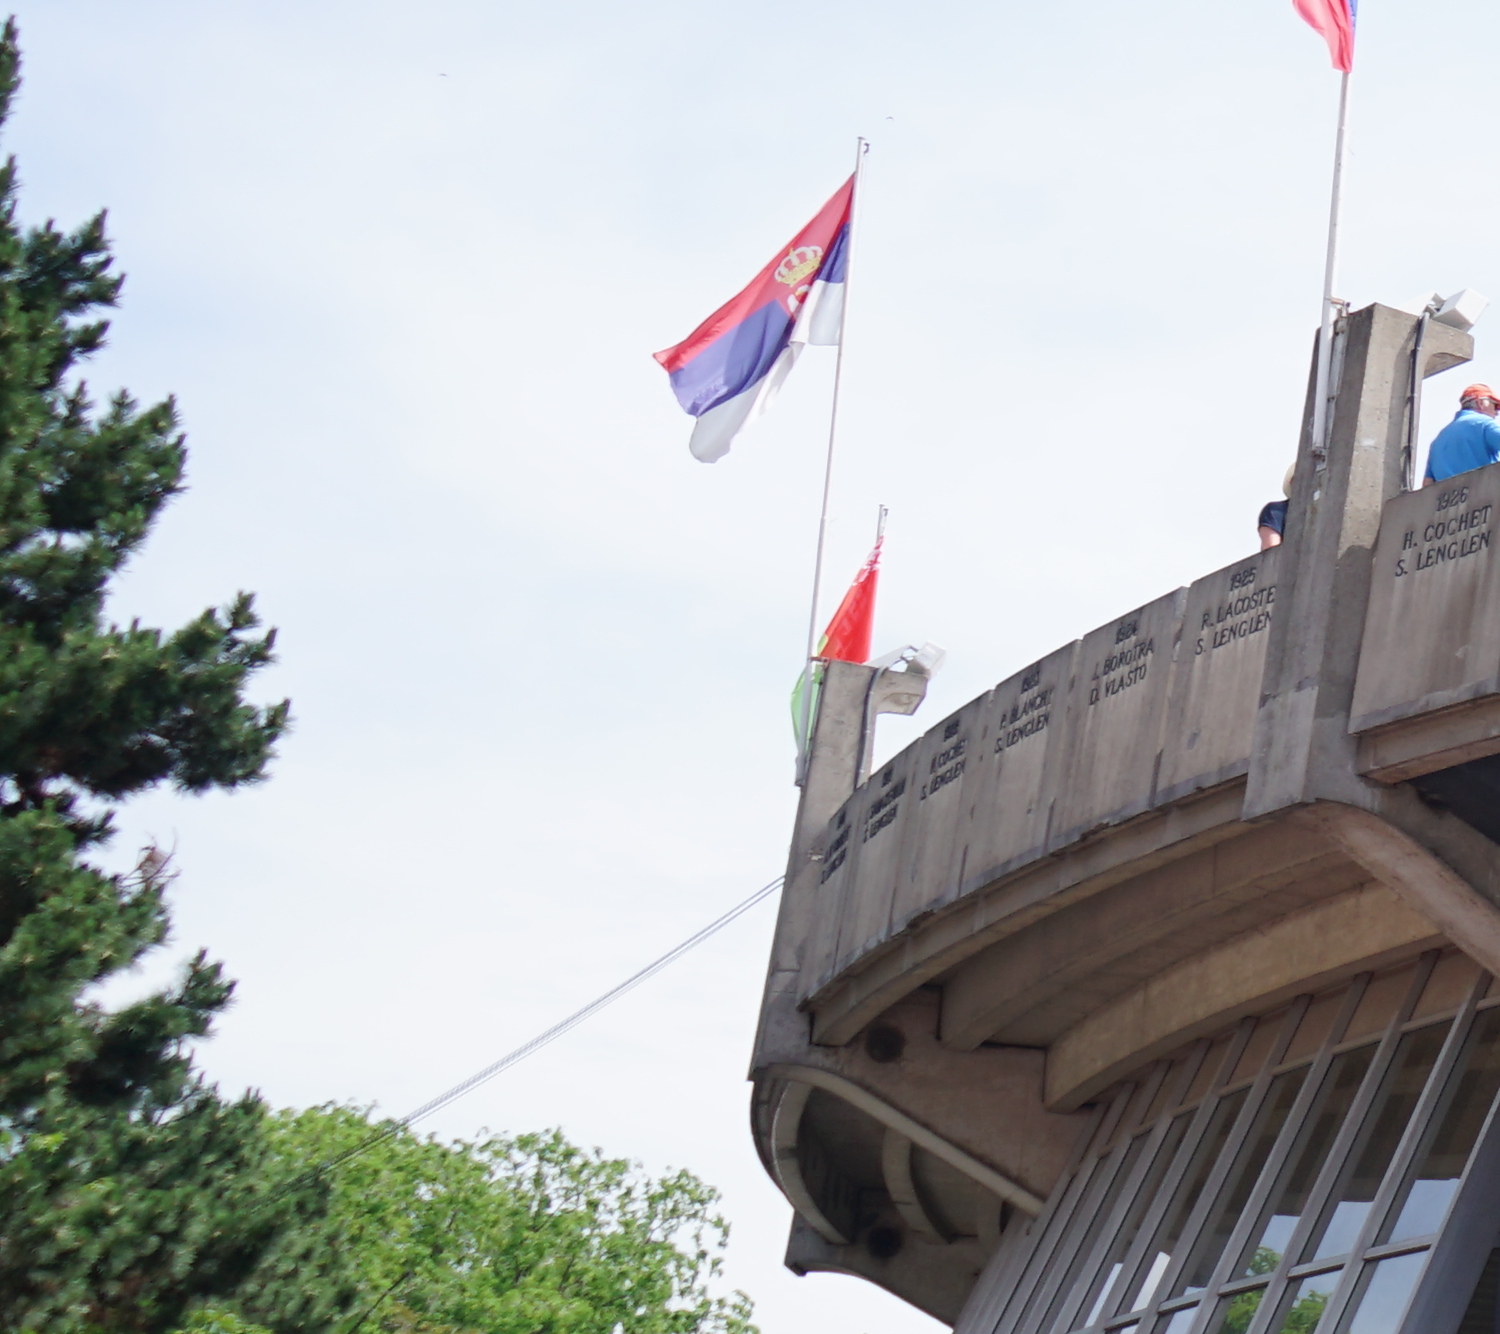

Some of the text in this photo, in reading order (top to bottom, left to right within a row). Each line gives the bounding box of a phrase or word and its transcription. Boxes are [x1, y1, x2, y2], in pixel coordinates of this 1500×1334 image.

[1436, 487, 1467, 512] 1926
[1403, 504, 1493, 550] H. COCHET
[1395, 530, 1492, 577] S. LENGLEN
[1230, 567, 1257, 592] 1925
[1201, 586, 1276, 631] R. LACOSTE
[1103, 638, 1155, 677] BOROTRA
[1194, 638, 1206, 656] S.
[1089, 664, 1147, 706] D. VLASTO
[994, 712, 1050, 754] S. LENGLEN
